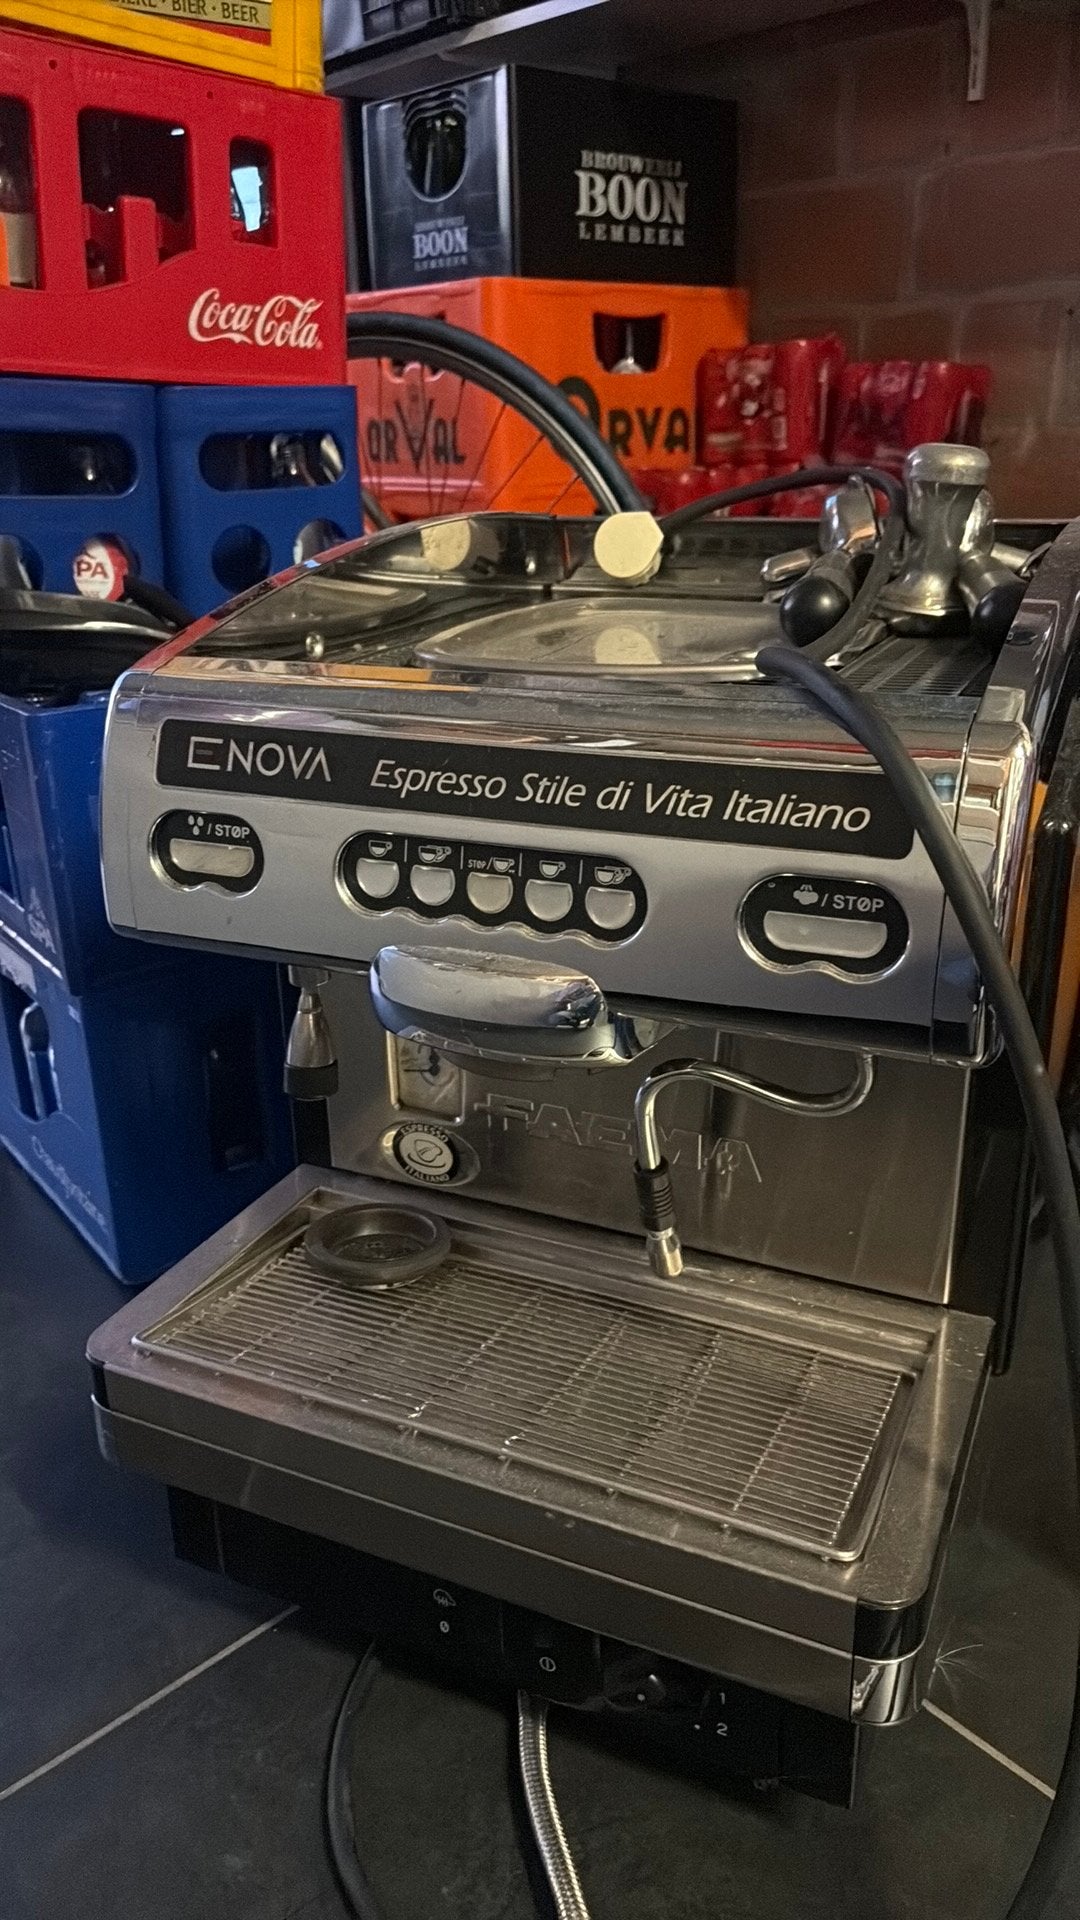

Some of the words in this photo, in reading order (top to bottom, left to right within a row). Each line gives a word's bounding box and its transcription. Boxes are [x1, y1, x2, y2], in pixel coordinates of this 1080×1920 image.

[172, 0, 207, 15] BIER
[221, 3, 259, 23] BEER
[574, 169, 688, 225] BOON
[412, 226, 468, 259] BOON
[188, 287, 323, 349] Coca-Cola
[367, 398, 466, 473] ORVAL
[187, 736, 331, 782] ENOVA
[370, 759, 507, 799] Espresso
[515, 772, 586, 807] Stile
[596, 780, 635, 811] di
[645, 782, 713, 819] Vita
[722, 789, 872, 833] Italiano
[716, 1722, 728, 1736] 2
